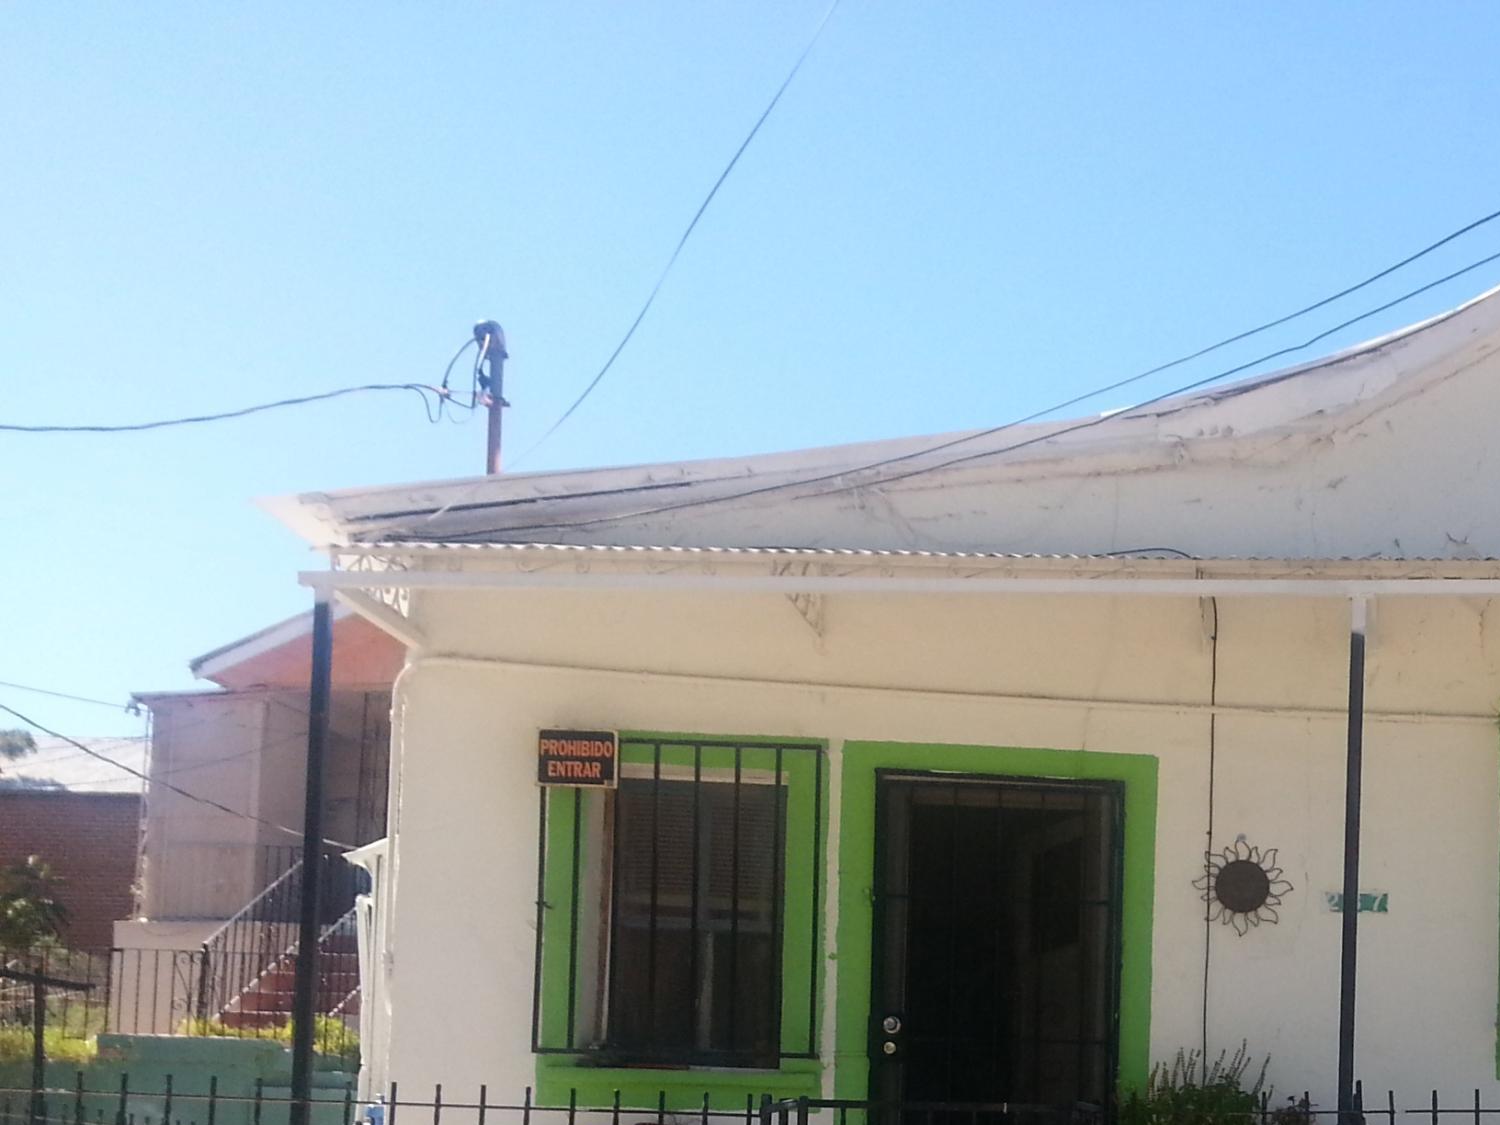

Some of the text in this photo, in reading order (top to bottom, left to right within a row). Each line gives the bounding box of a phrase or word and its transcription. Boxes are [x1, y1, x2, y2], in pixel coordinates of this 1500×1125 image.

[540, 739, 613, 757] PROHIBIDO
[547, 761, 601, 778] ENTRAR
[1327, 891, 1383, 912] 27
